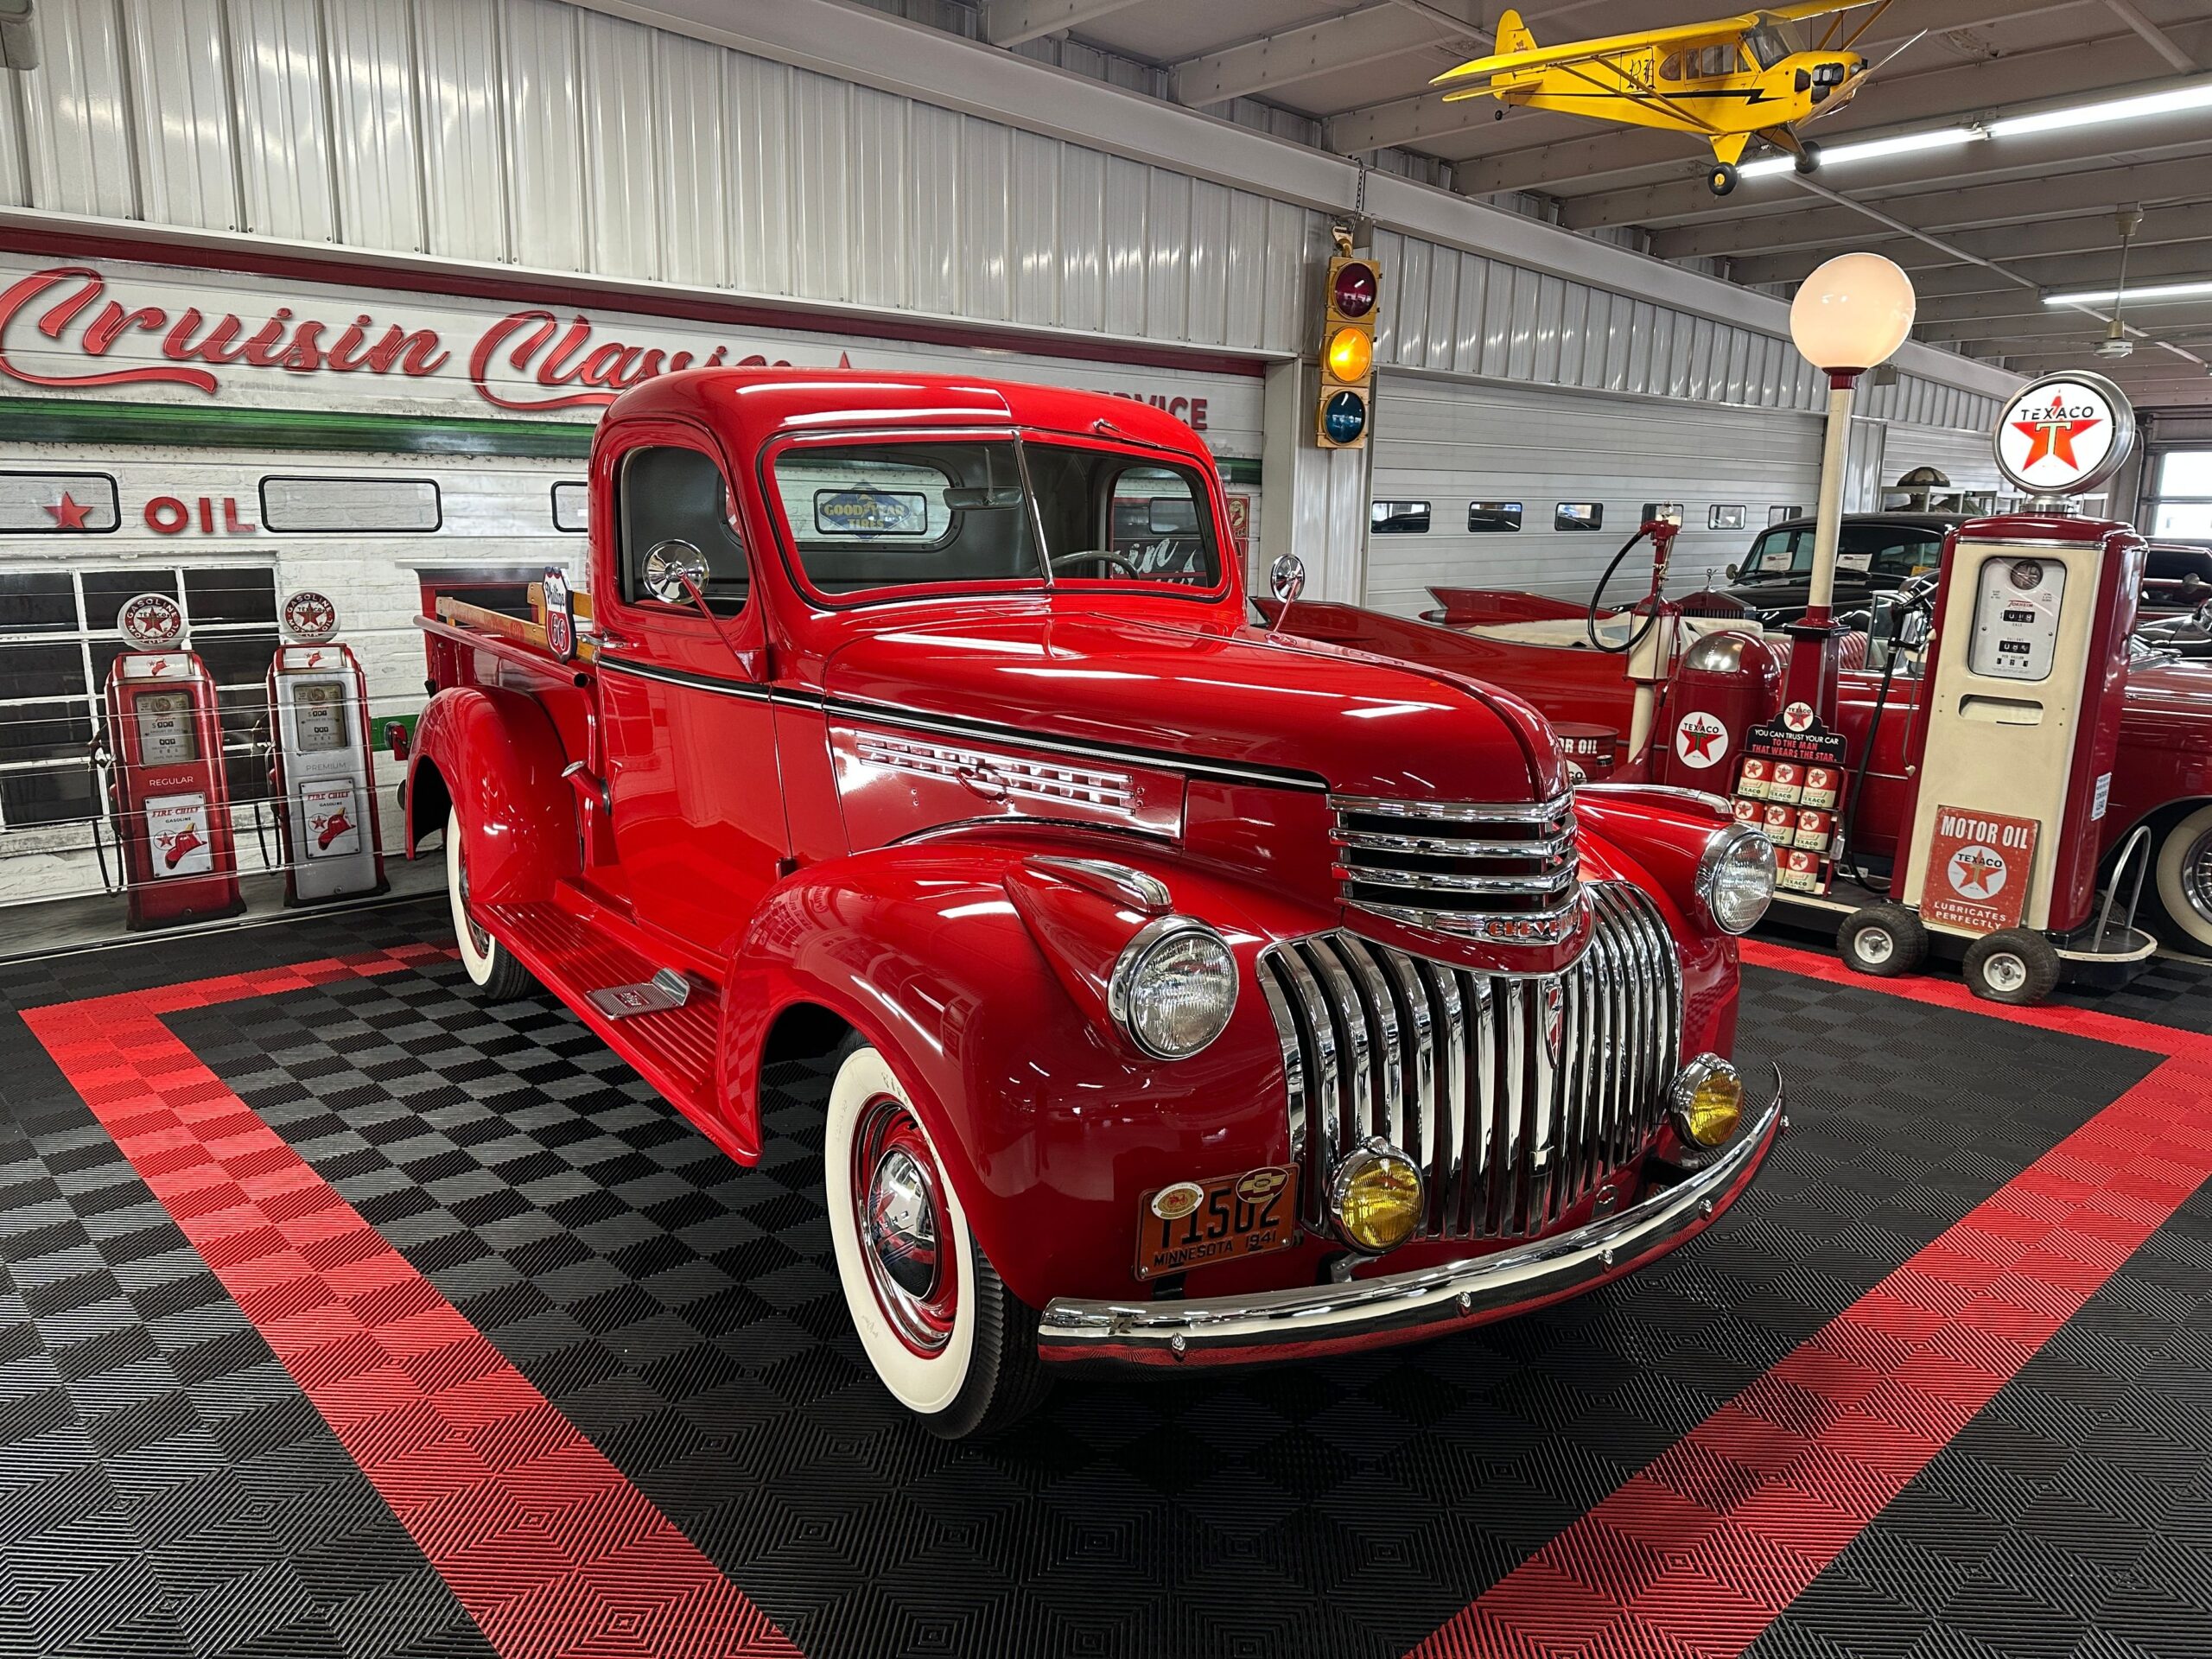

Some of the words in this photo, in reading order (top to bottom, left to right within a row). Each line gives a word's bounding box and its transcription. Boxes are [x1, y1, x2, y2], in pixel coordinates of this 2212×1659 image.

[0, 266, 450, 394] Cruisin
[2020, 405, 2094, 421] TEXACO
[143, 495, 257, 534] OIL
[847, 518, 885, 529] TIRES
[126, 598, 178, 619] GASOLINE
[286, 594, 332, 613] GASOLINE
[166, 623, 180, 638] OIL
[550, 612, 566, 652] 66
[1683, 722, 1719, 734] TEXACO
[1754, 728, 1769, 737] YOU
[1769, 730, 1784, 739] CAN
[1785, 732, 1805, 741] TRUST
[1805, 734, 1824, 743] YOUR
[1824, 736, 1840, 745] CAR
[1578, 739, 1598, 754] OIL
[1751, 743, 1770, 753] THAT
[1771, 746, 1798, 758] WEARS
[1799, 750, 1815, 760] THE
[1772, 738, 1781, 747] TO
[1783, 739, 1797, 748] THE
[1798, 741, 1818, 751] MAN
[306, 762, 346, 772] PREMIUM
[149, 776, 194, 787] REGULAR
[1940, 815, 1999, 844] MOTOR
[2001, 824, 2028, 849] OIL
[1957, 853, 2003, 868] TEXACO
[1934, 901, 2007, 922] LUBRICATES
[1935, 911, 2003, 931] PERFECTLY
[1154, 1238, 1234, 1267] MINNESOTA
[1245, 1230, 1277, 1249] 1941
